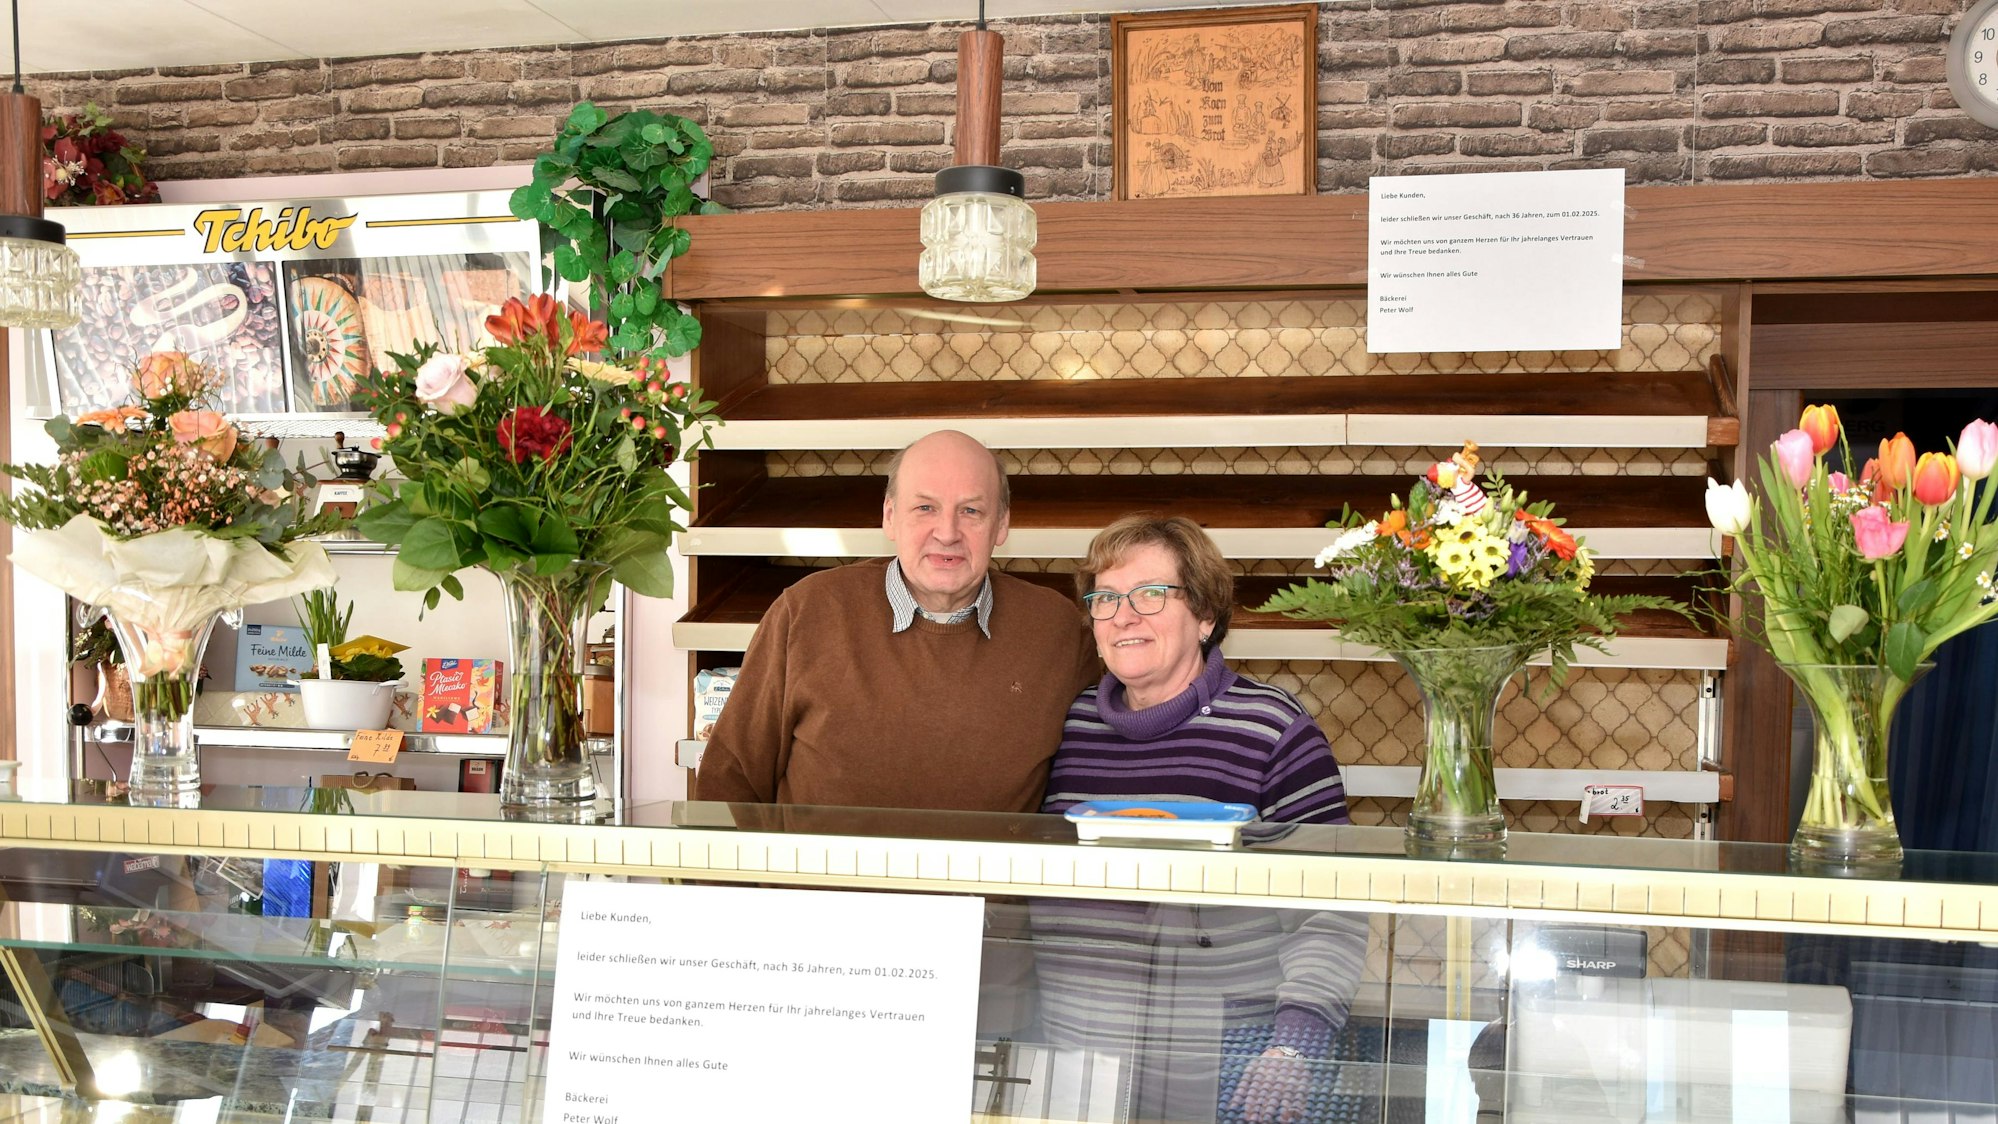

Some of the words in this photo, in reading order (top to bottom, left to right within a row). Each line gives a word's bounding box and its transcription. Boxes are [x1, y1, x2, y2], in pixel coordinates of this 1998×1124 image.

[1981, 27, 1995, 41] 10
[1974, 50, 1983, 64] 9
[1978, 72, 1988, 86] 8
[1203, 115, 1223, 127] zum
[1561, 210, 1600, 218] 01.02.2025.
[194, 206, 359, 253] Tchibo
[1521, 235, 1559, 243] jahrelanges
[250, 643, 277, 657] Feine
[278, 645, 307, 658] Milde
[429, 671, 464, 687] Ptasie
[581, 912, 607, 921] Liebe
[610, 913, 651, 924] Kunden,
[577, 952, 606, 962] leider
[609, 953, 656, 964] schließen
[660, 956, 676, 965] wir
[679, 958, 708, 967] unser
[711, 959, 759, 971] Geschäft,
[763, 962, 787, 971] nach
[792, 963, 804, 972] 36
[807, 964, 845, 976] Jahren,
[849, 967, 871, 975] zum
[875, 967, 937, 979] 01.02.2025.
[1566, 958, 1617, 970] SHARP
[574, 992, 592, 1002] Wir
[595, 995, 639, 1005] möchten
[643, 998, 660, 1006] uns
[664, 999, 682, 1007] von
[685, 1000, 725, 1010] ganzem
[729, 1002, 765, 1012] Herzen
[769, 1002, 783, 1013] für
[787, 1005, 801, 1014] Ihr
[804, 1006, 866, 1020] jahrelanges
[870, 1010, 924, 1021] Vertrauen
[572, 1010, 591, 1019] und
[595, 1011, 614, 1021] Ihre
[618, 1013, 646, 1023] Treue
[650, 1014, 703, 1026] bedanken.
[569, 1051, 586, 1060] Wir
[590, 1053, 641, 1064] wünschen
[644, 1056, 673, 1067] Ihnen
[676, 1058, 699, 1068] alles
[703, 1060, 728, 1070] Gute
[565, 1092, 608, 1104] Bäckerei
[563, 1113, 590, 1123] Peter
